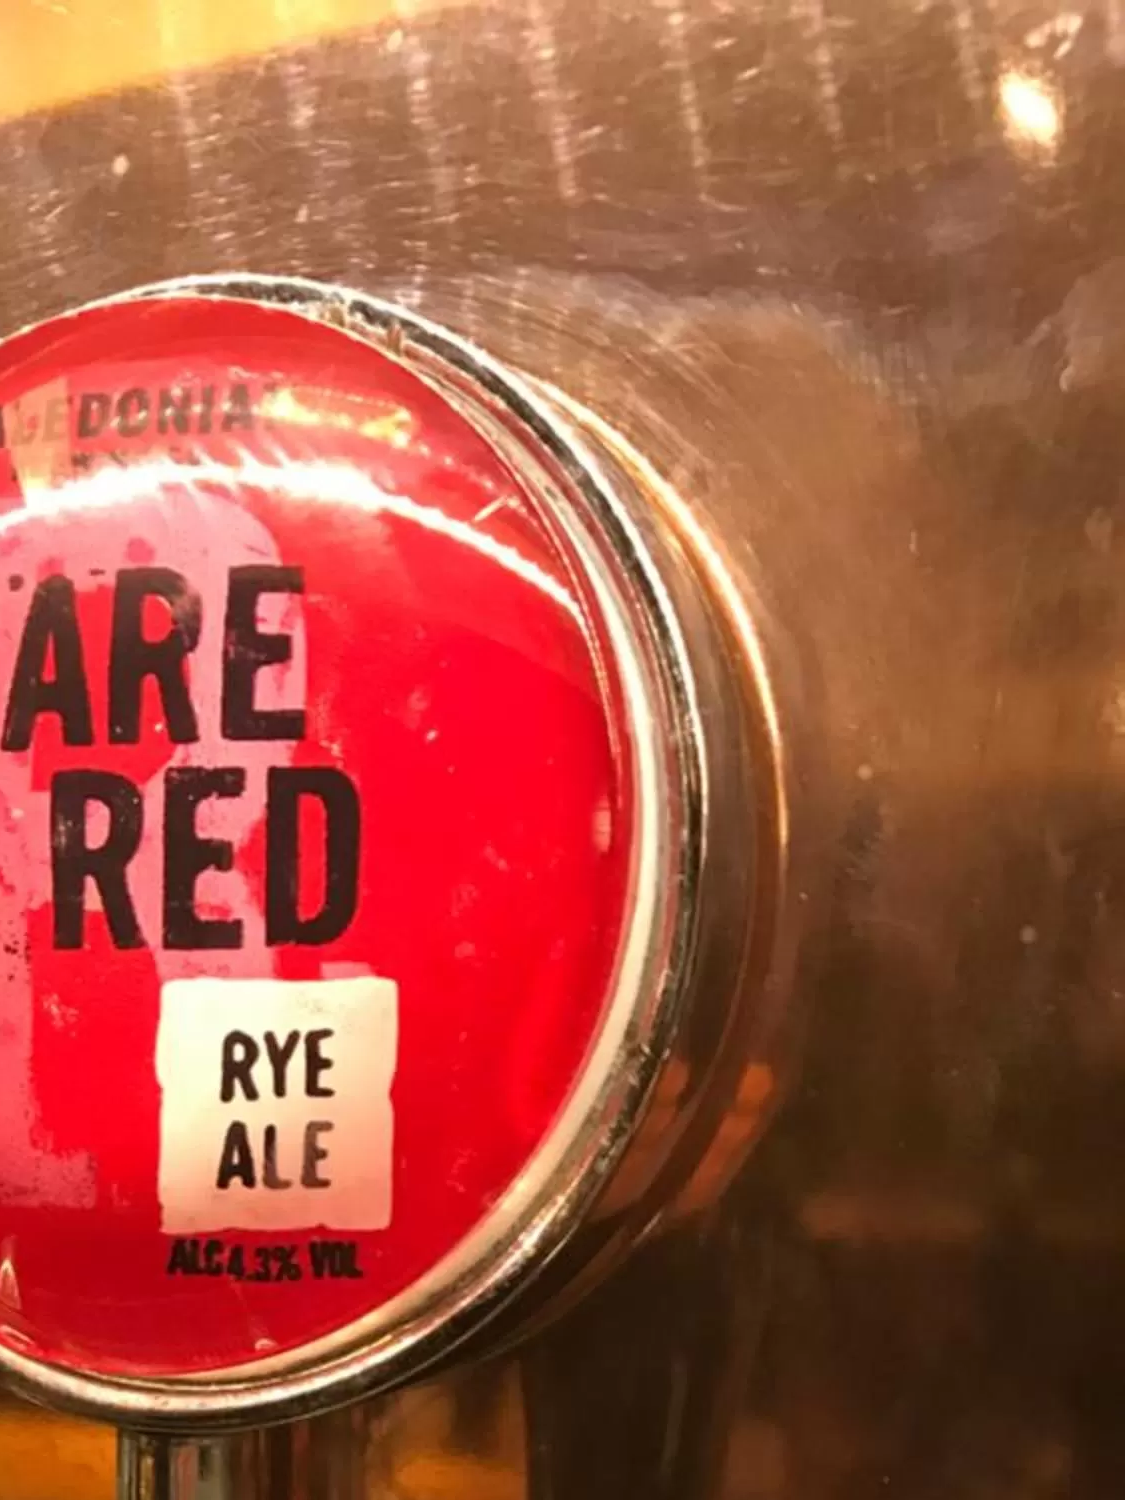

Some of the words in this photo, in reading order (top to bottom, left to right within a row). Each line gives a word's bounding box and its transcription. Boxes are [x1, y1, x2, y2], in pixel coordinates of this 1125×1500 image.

[50, 765, 361, 950] RED
[220, 1029, 335, 1103] RYE
[215, 1120, 335, 1190] ALE
[166, 1239, 225, 1278] ALC
[308, 1239, 365, 1280] VOL
